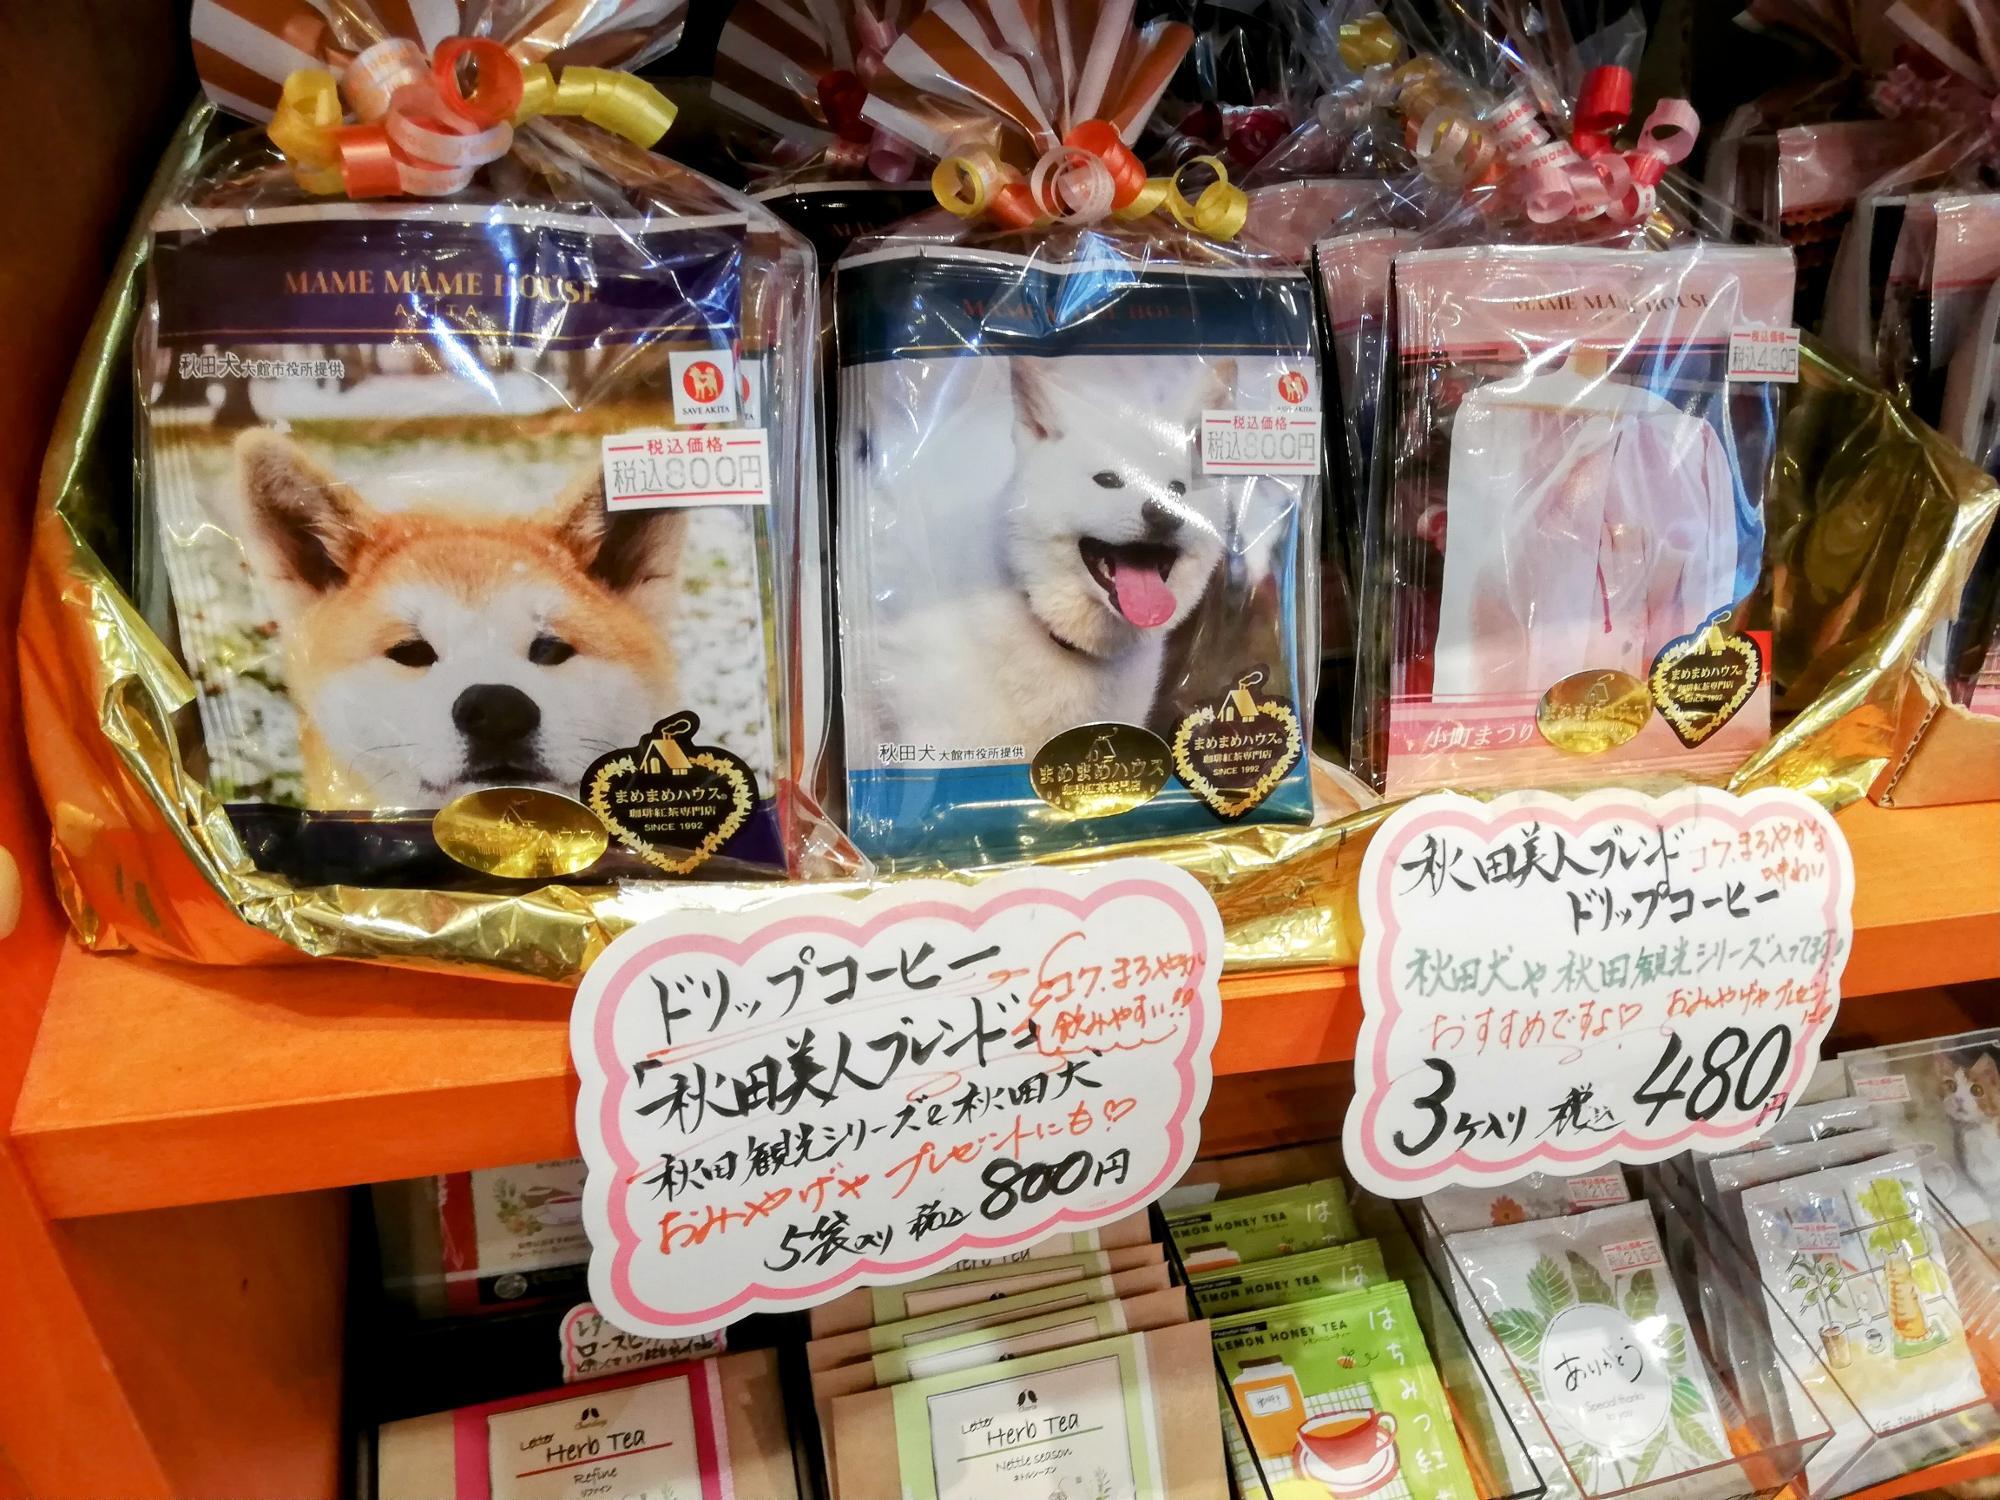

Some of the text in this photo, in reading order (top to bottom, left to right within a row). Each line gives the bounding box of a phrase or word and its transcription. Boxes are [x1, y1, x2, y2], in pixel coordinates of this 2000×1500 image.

[285, 269, 375, 294] MAME
[383, 269, 483, 296] MAME
[180, 352, 345, 380] 秋田犬 大館市役所提供
[682, 405, 730, 415] SAVE AKITA
[1232, 415, 1288, 431] 税込価格
[647, 436, 724, 456] 税込価格
[1207, 431, 1316, 461] 税込800円
[612, 455, 764, 494] 税込800円
[1671, 664, 1739, 681] まめまめハウス
[880, 743, 1024, 762] 秋田犬 大館市役所提供
[1194, 732, 1278, 751] まめまめハウス
[1039, 758, 1165, 785] まめまめハウス
[1212, 764, 1260, 776] SINCE 1992
[615, 786, 721, 804] まめまめハウス
[644, 821, 704, 832] SINCE 1992
[1400, 821, 1685, 897] 秋田美人ブレンド
[1566, 881, 1781, 935] ドリップコーヒー
[649, 942, 1002, 1046] ドリップコーヒー
[1170, 1224, 1210, 1239] EMON
[1214, 1215, 1258, 1232] HONEY
[1262, 1211, 1288, 1223] TEA
[1200, 1289, 1240, 1304] EMON
[1244, 1280, 1290, 1297] HONEY
[1295, 1274, 1321, 1287] TEA
[1217, 1335, 1265, 1352] LEMON
[1270, 1326, 1316, 1343] HONEY
[1323, 1319, 1349, 1331] TEA
[987, 1412, 1080, 1447] Herb Tea
[546, 1429, 647, 1463] Herb Tea
[1033, 1448, 1073, 1465] season
[573, 1466, 618, 1485] Refine
